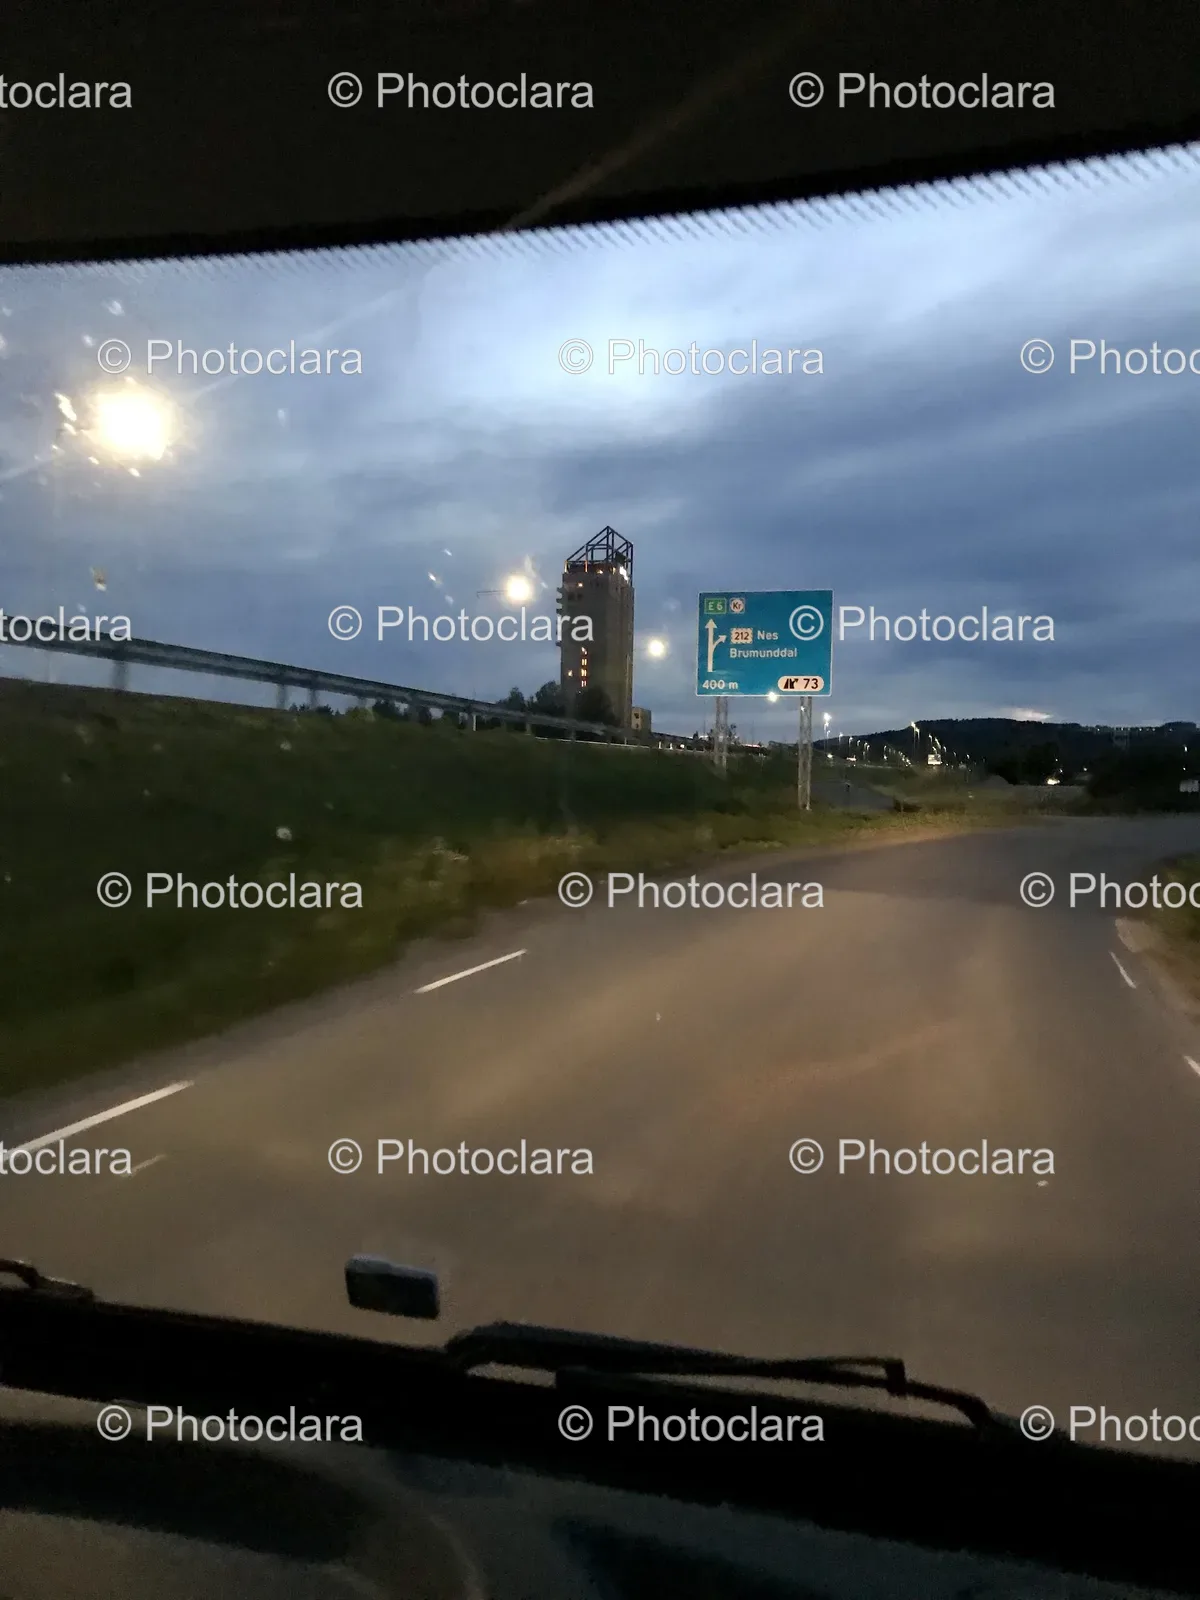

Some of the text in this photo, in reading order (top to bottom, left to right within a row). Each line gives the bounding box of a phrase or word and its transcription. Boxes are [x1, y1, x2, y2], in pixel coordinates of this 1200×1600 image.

[708, 602, 723, 610] E 6
[734, 631, 778, 640] 212 Nes
[730, 648, 797, 657] Brumunddal
[702, 680, 725, 689] 400
[803, 678, 819, 689] 73
